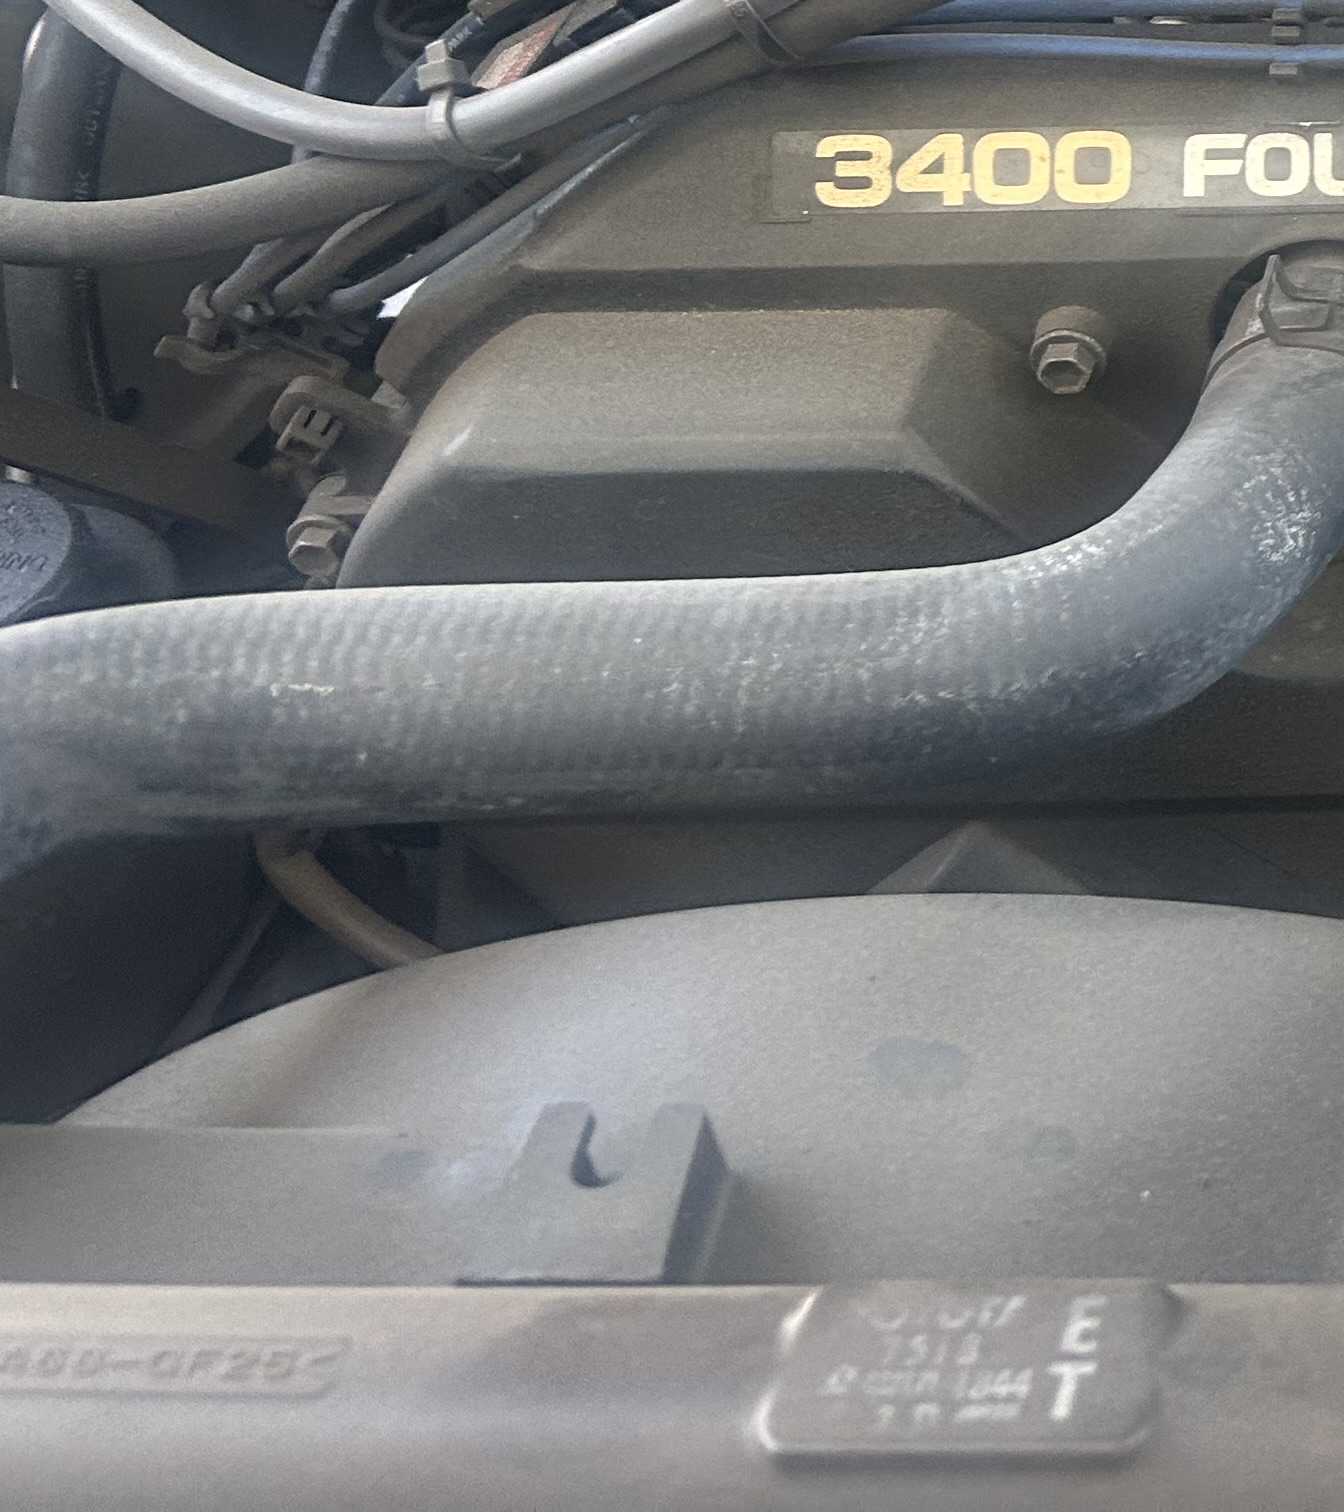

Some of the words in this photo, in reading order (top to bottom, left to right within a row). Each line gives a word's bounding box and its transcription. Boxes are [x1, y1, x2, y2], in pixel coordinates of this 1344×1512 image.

[813, 130, 1131, 209] 3400
[1060, 1294, 1108, 1354] E
[1046, 1360, 1099, 1422] T
